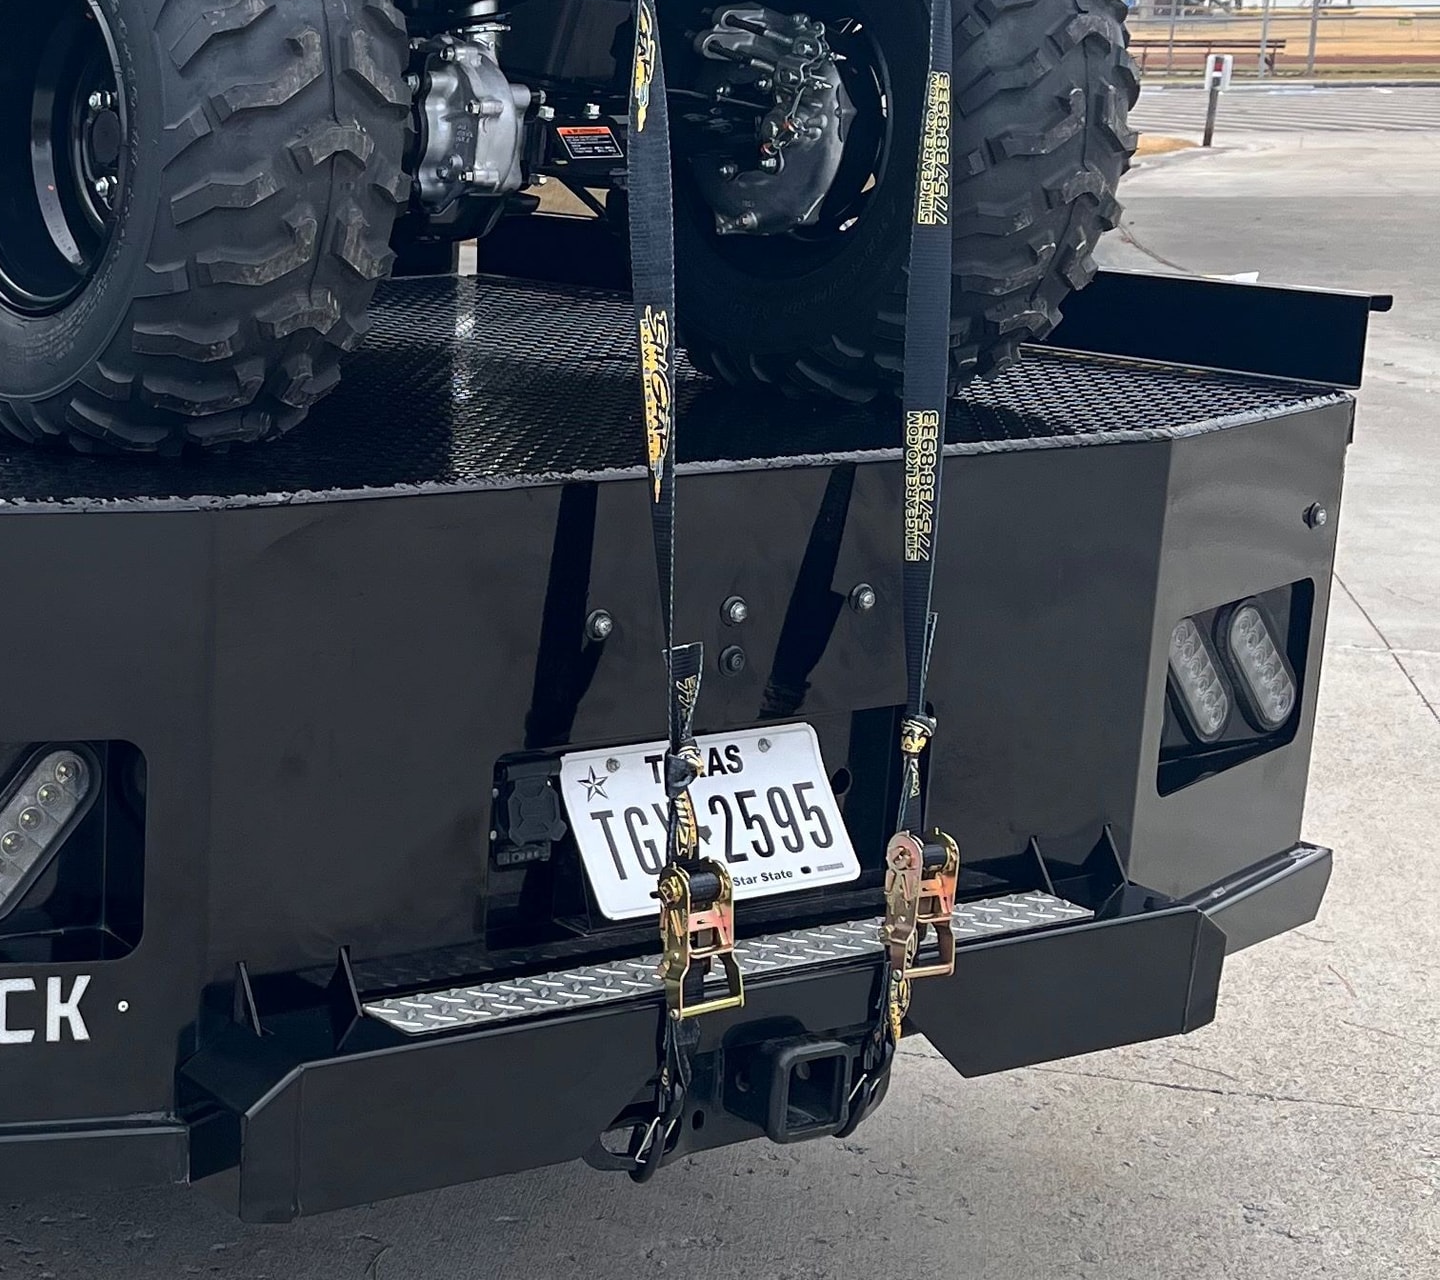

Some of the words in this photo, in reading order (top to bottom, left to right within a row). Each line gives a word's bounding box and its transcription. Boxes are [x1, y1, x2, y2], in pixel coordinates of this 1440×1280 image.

[933, 72, 950, 224] 775-738-8933
[917, 410, 939, 561] 775-738-8933
[645, 744, 744, 783] TAS
[708, 782, 834, 863] 2595
[733, 874, 758, 887] Star
[761, 869, 793, 882] State
